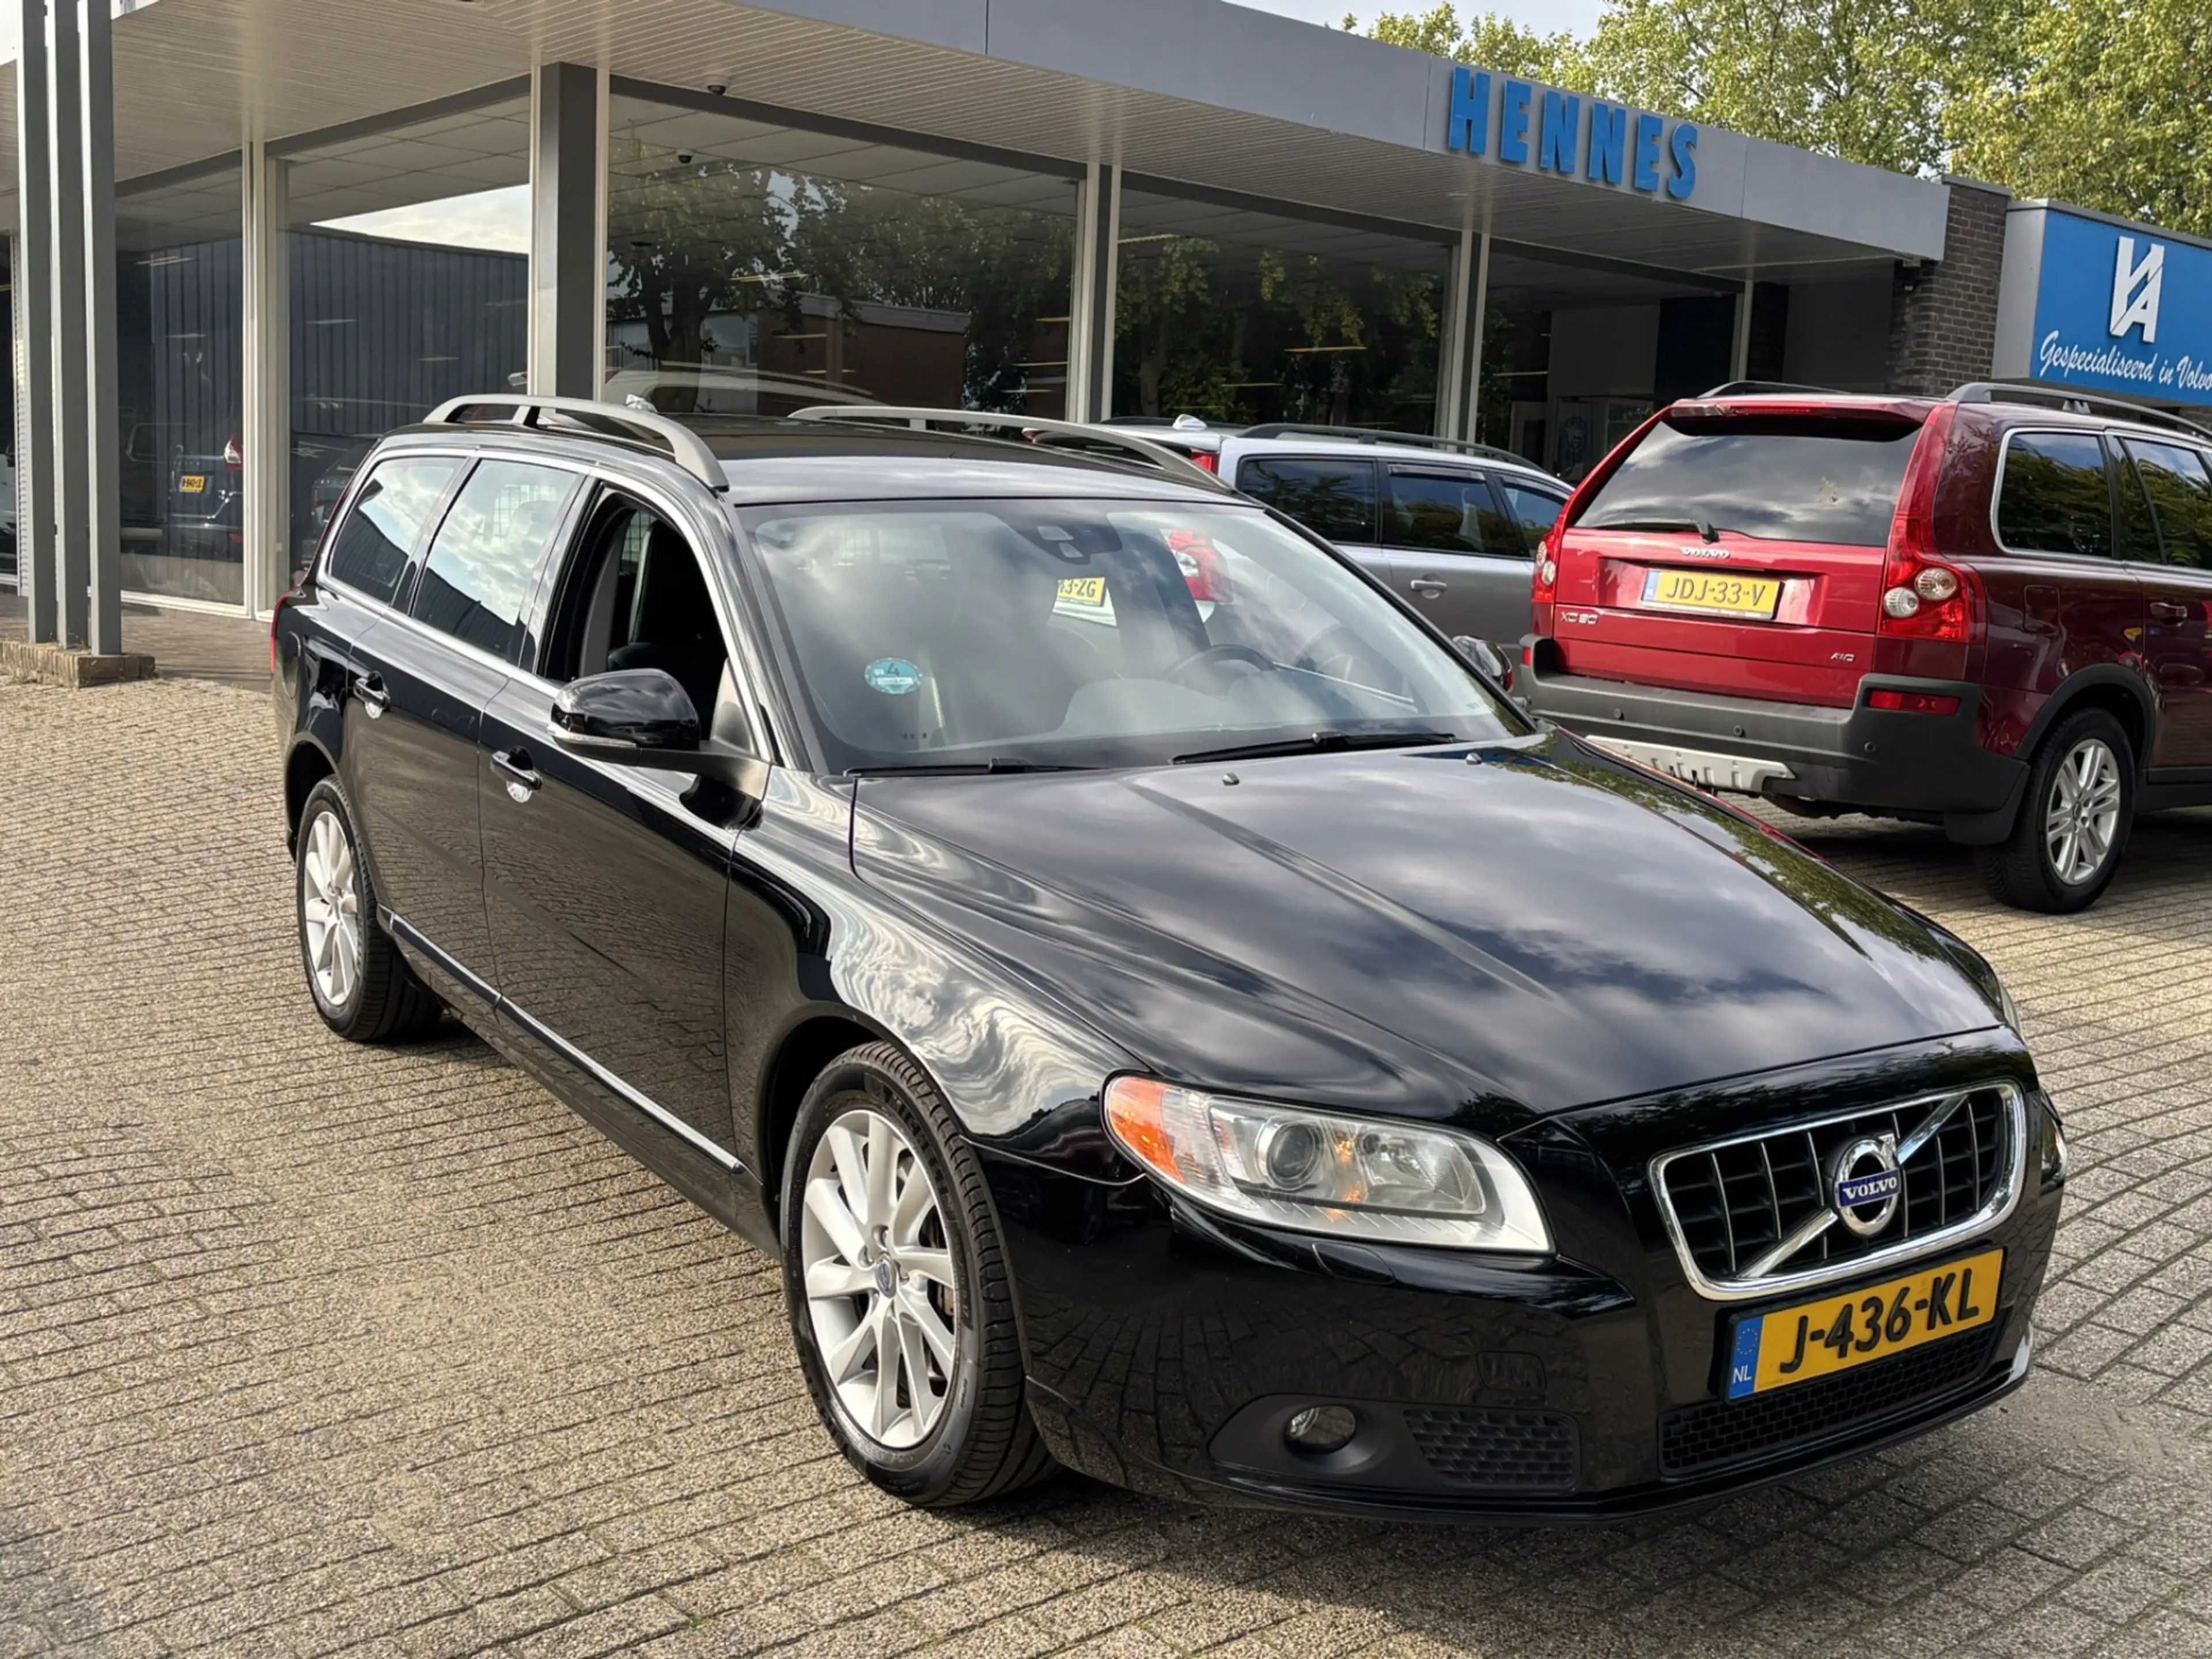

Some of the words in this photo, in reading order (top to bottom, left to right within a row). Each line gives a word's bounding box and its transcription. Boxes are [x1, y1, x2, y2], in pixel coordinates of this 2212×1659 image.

[1449, 66, 1698, 199] HENNES
[2039, 330, 2158, 382] Gespecialiseerd
[2158, 359, 2174, 385] in
[1680, 547, 1731, 559] VOLVO
[1665, 577, 1767, 607] JDJ-33-V
[887, 662, 900, 677] 4
[1842, 1177, 1897, 1200] VOLVO
[1779, 1268, 1979, 1374] J-436-KL
[1732, 1365, 1752, 1384] NL
